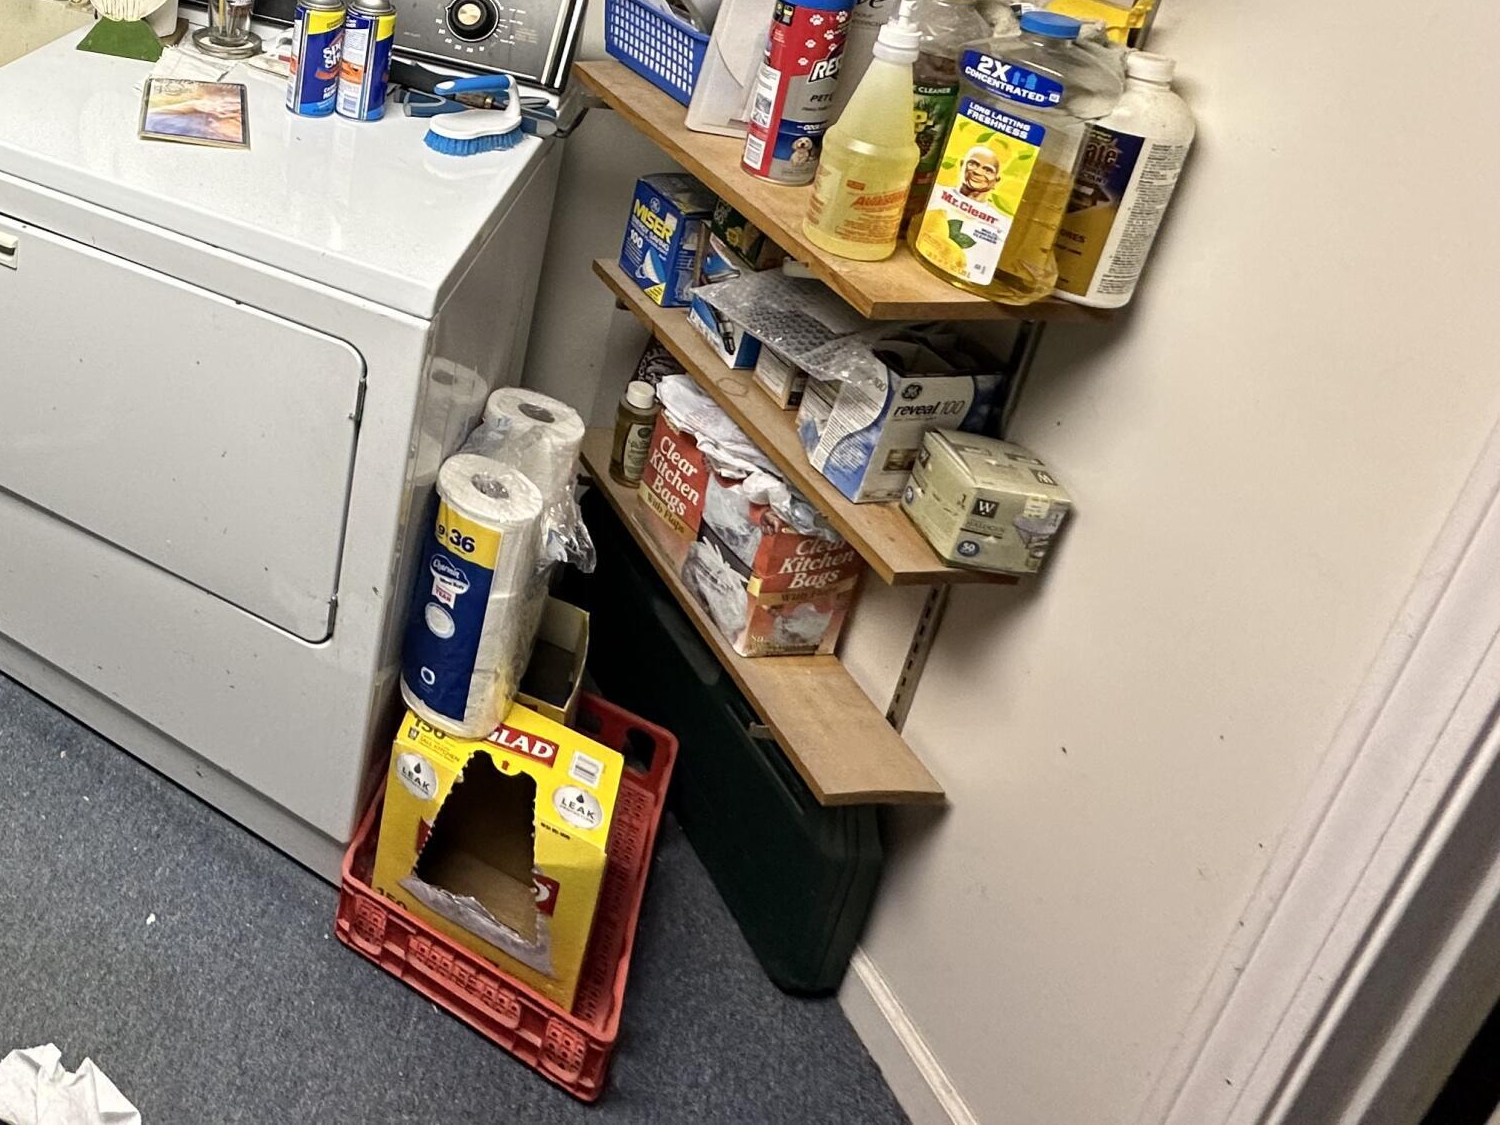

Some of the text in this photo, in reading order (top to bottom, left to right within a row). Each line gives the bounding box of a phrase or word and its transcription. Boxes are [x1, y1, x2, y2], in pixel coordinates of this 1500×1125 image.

[809, 59, 839, 83] RES
[977, 54, 1013, 83] 2X
[918, 86, 952, 94] CLEANER
[964, 65, 1046, 103] CONCENTRATED
[966, 108, 1029, 140] FRESHNESS
[969, 101, 1031, 132] LONG LASTING
[1085, 143, 1118, 165] ate
[633, 198, 672, 245] MISER
[630, 229, 644, 249] 100
[893, 399, 966, 418] reveal 100
[660, 435, 698, 478] Clear
[649, 448, 700, 507] Kitchen
[652, 473, 687, 516] Bags
[437, 524, 446, 535] 9
[449, 528, 476, 553] 36
[777, 549, 855, 575] Kitchen
[787, 569, 841, 589] Bags
[402, 766, 430, 792] LEAK
[561, 797, 595, 820] LEAK
